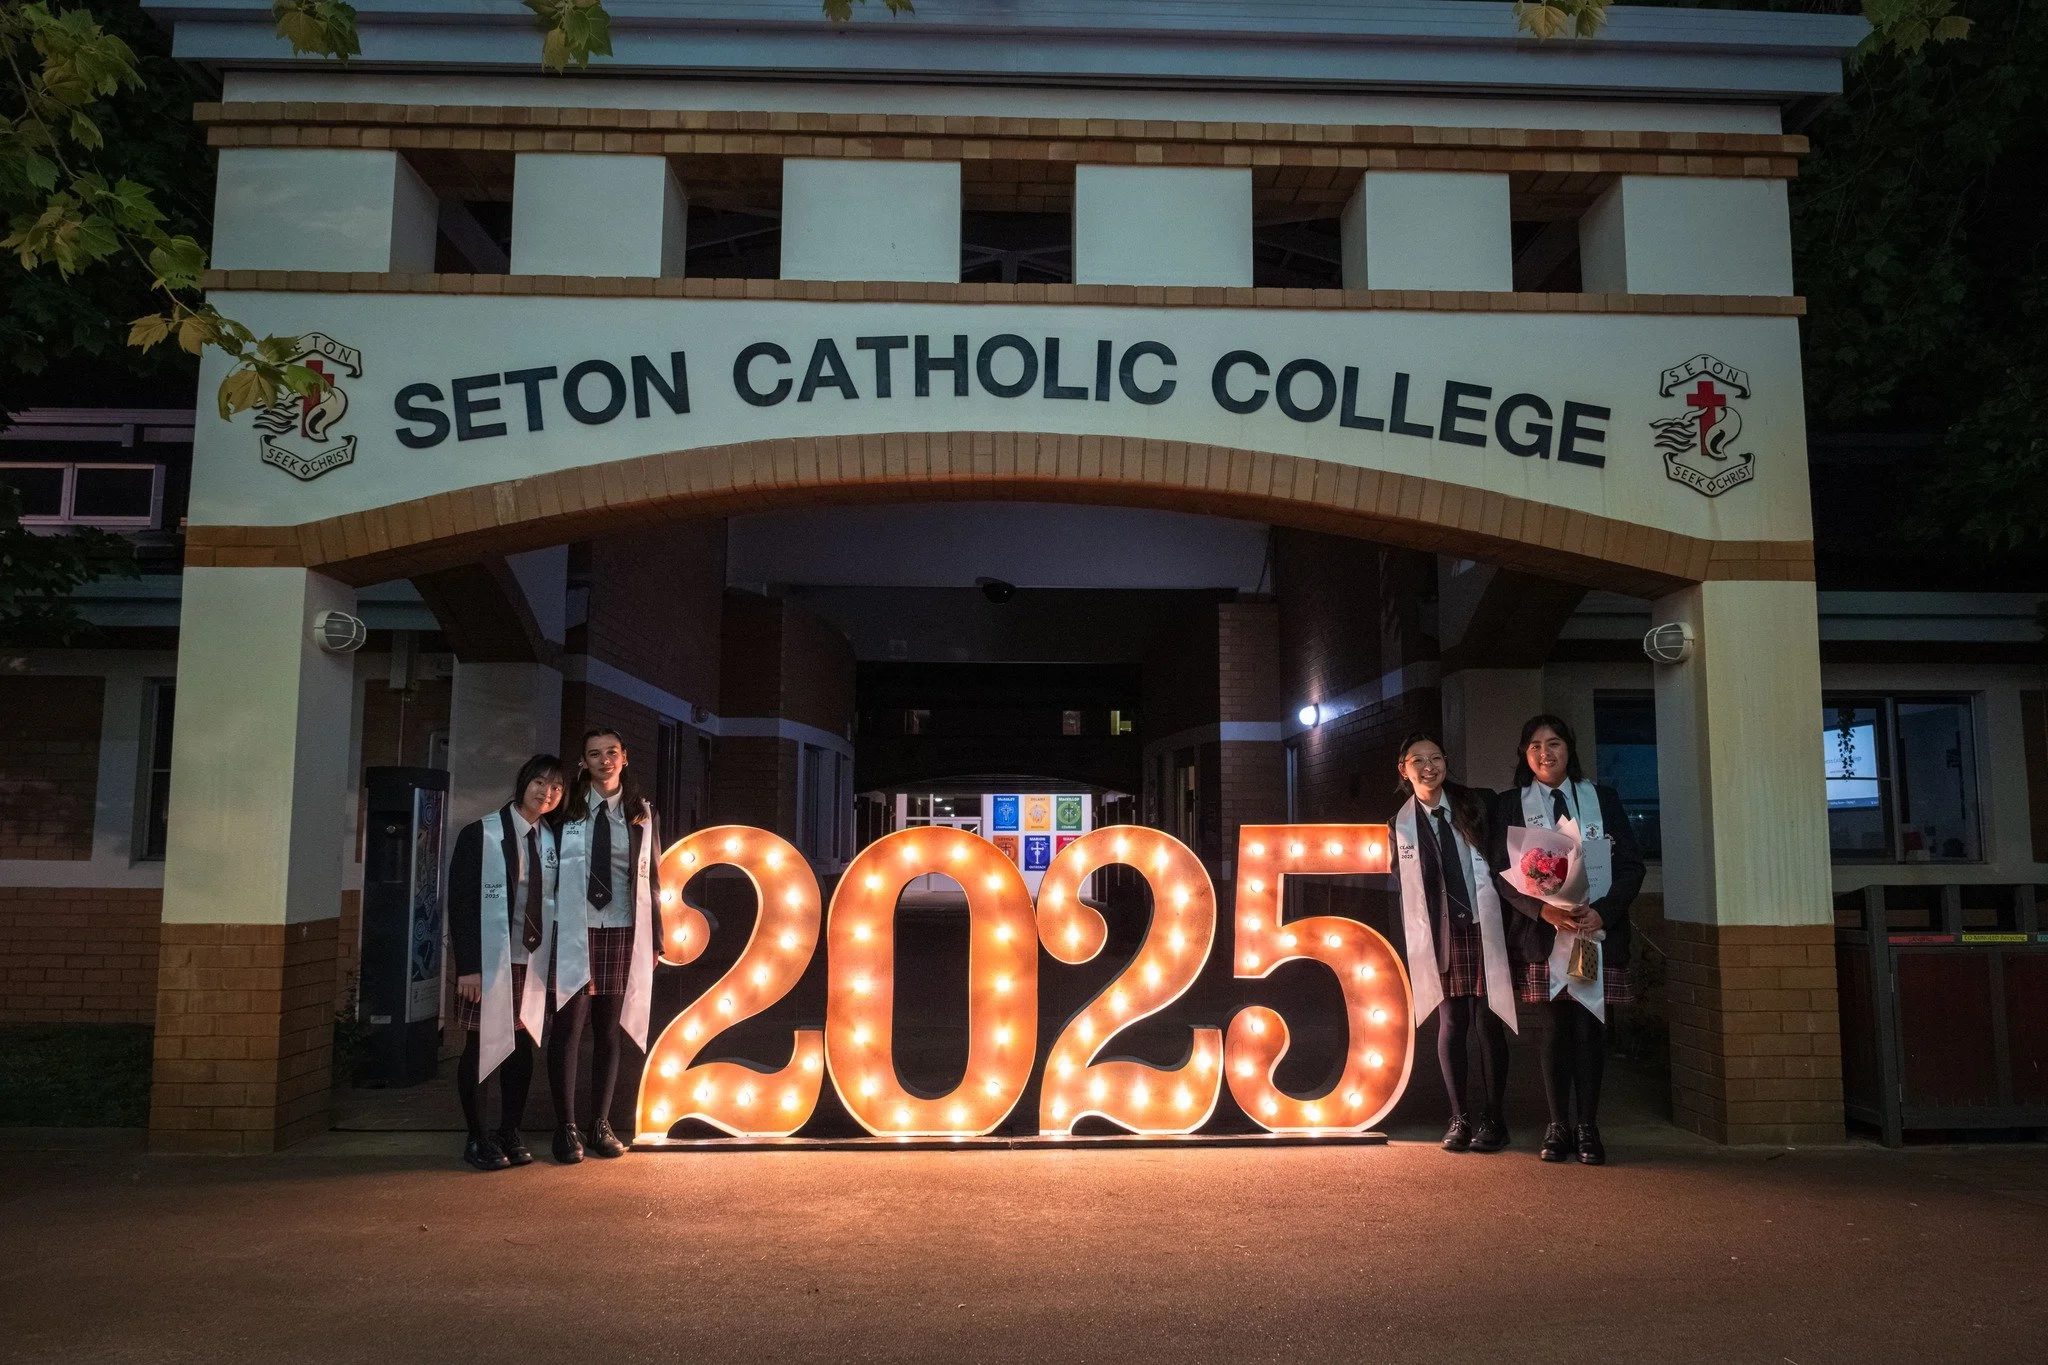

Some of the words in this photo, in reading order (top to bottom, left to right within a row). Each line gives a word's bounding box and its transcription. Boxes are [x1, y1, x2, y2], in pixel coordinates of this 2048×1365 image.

[293, 335, 352, 363] ETON
[1669, 356, 1739, 383] SETON
[394, 351, 691, 449] SETON
[733, 333, 1178, 407] CATHOLIC
[1211, 349, 1612, 469] COLLEGE
[266, 448, 299, 471] SEEK
[309, 448, 349, 472] CHRIST
[1673, 466, 1705, 488] SEEK
[1716, 465, 1751, 489] CHRIST
[1527, 814, 1544, 822] CLASS
[634, 823, 1415, 1140] 2025
